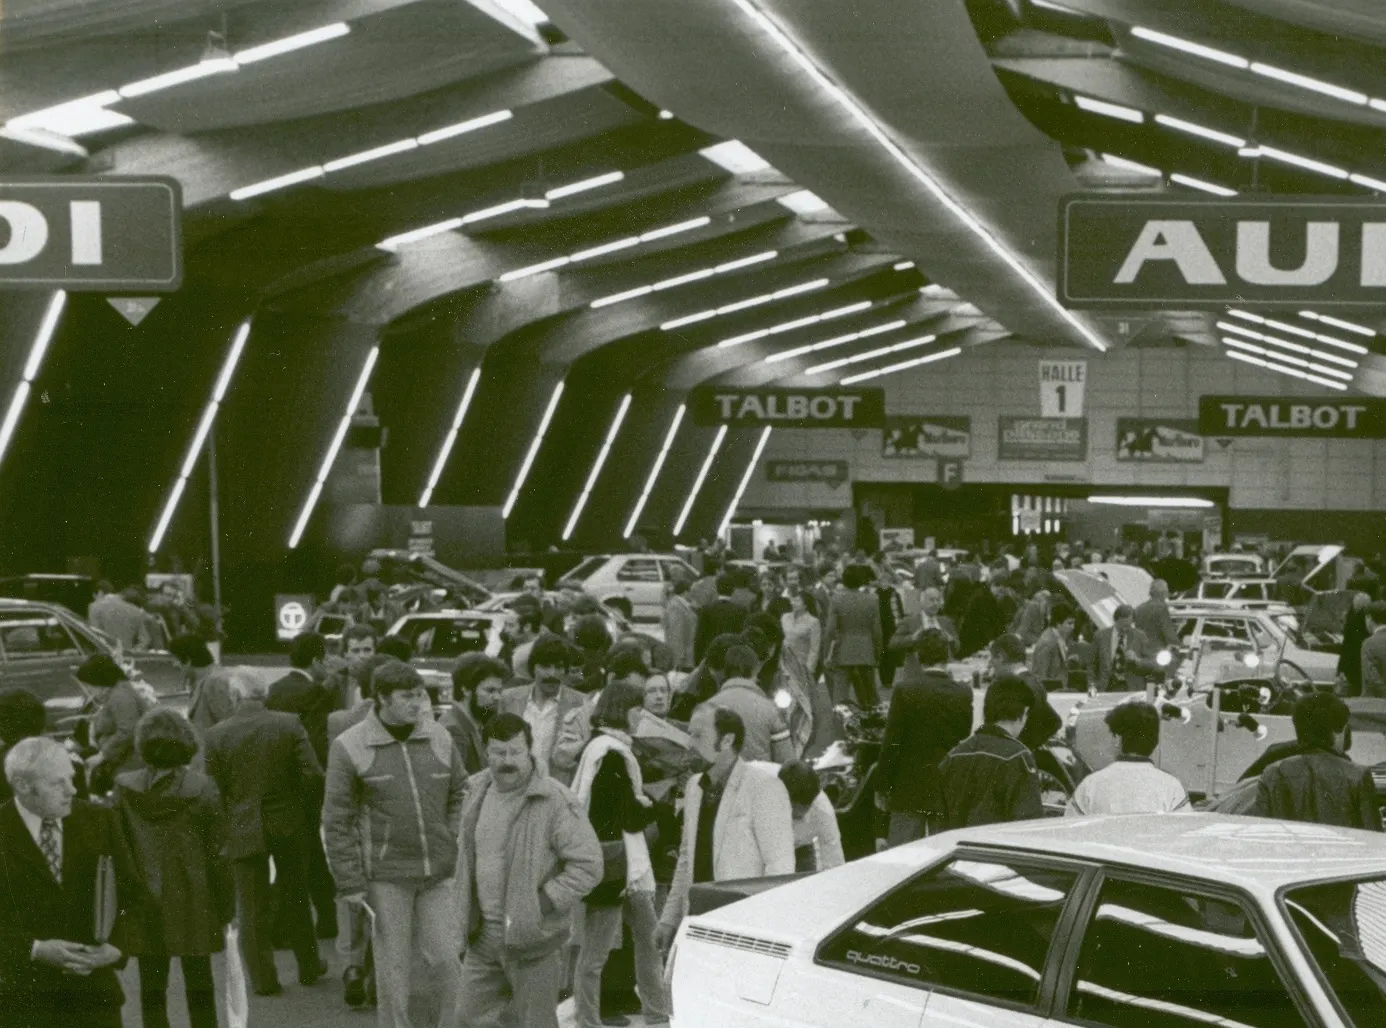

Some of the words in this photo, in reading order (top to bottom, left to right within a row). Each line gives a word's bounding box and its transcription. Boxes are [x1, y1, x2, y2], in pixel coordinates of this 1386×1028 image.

[1041, 364, 1084, 382] HALLE
[716, 394, 862, 420] TALBOT
[1054, 385, 1067, 412] 1
[1220, 402, 1367, 430] TALBOT
[943, 463, 957, 483] F
[845, 949, 921, 974] quattro
